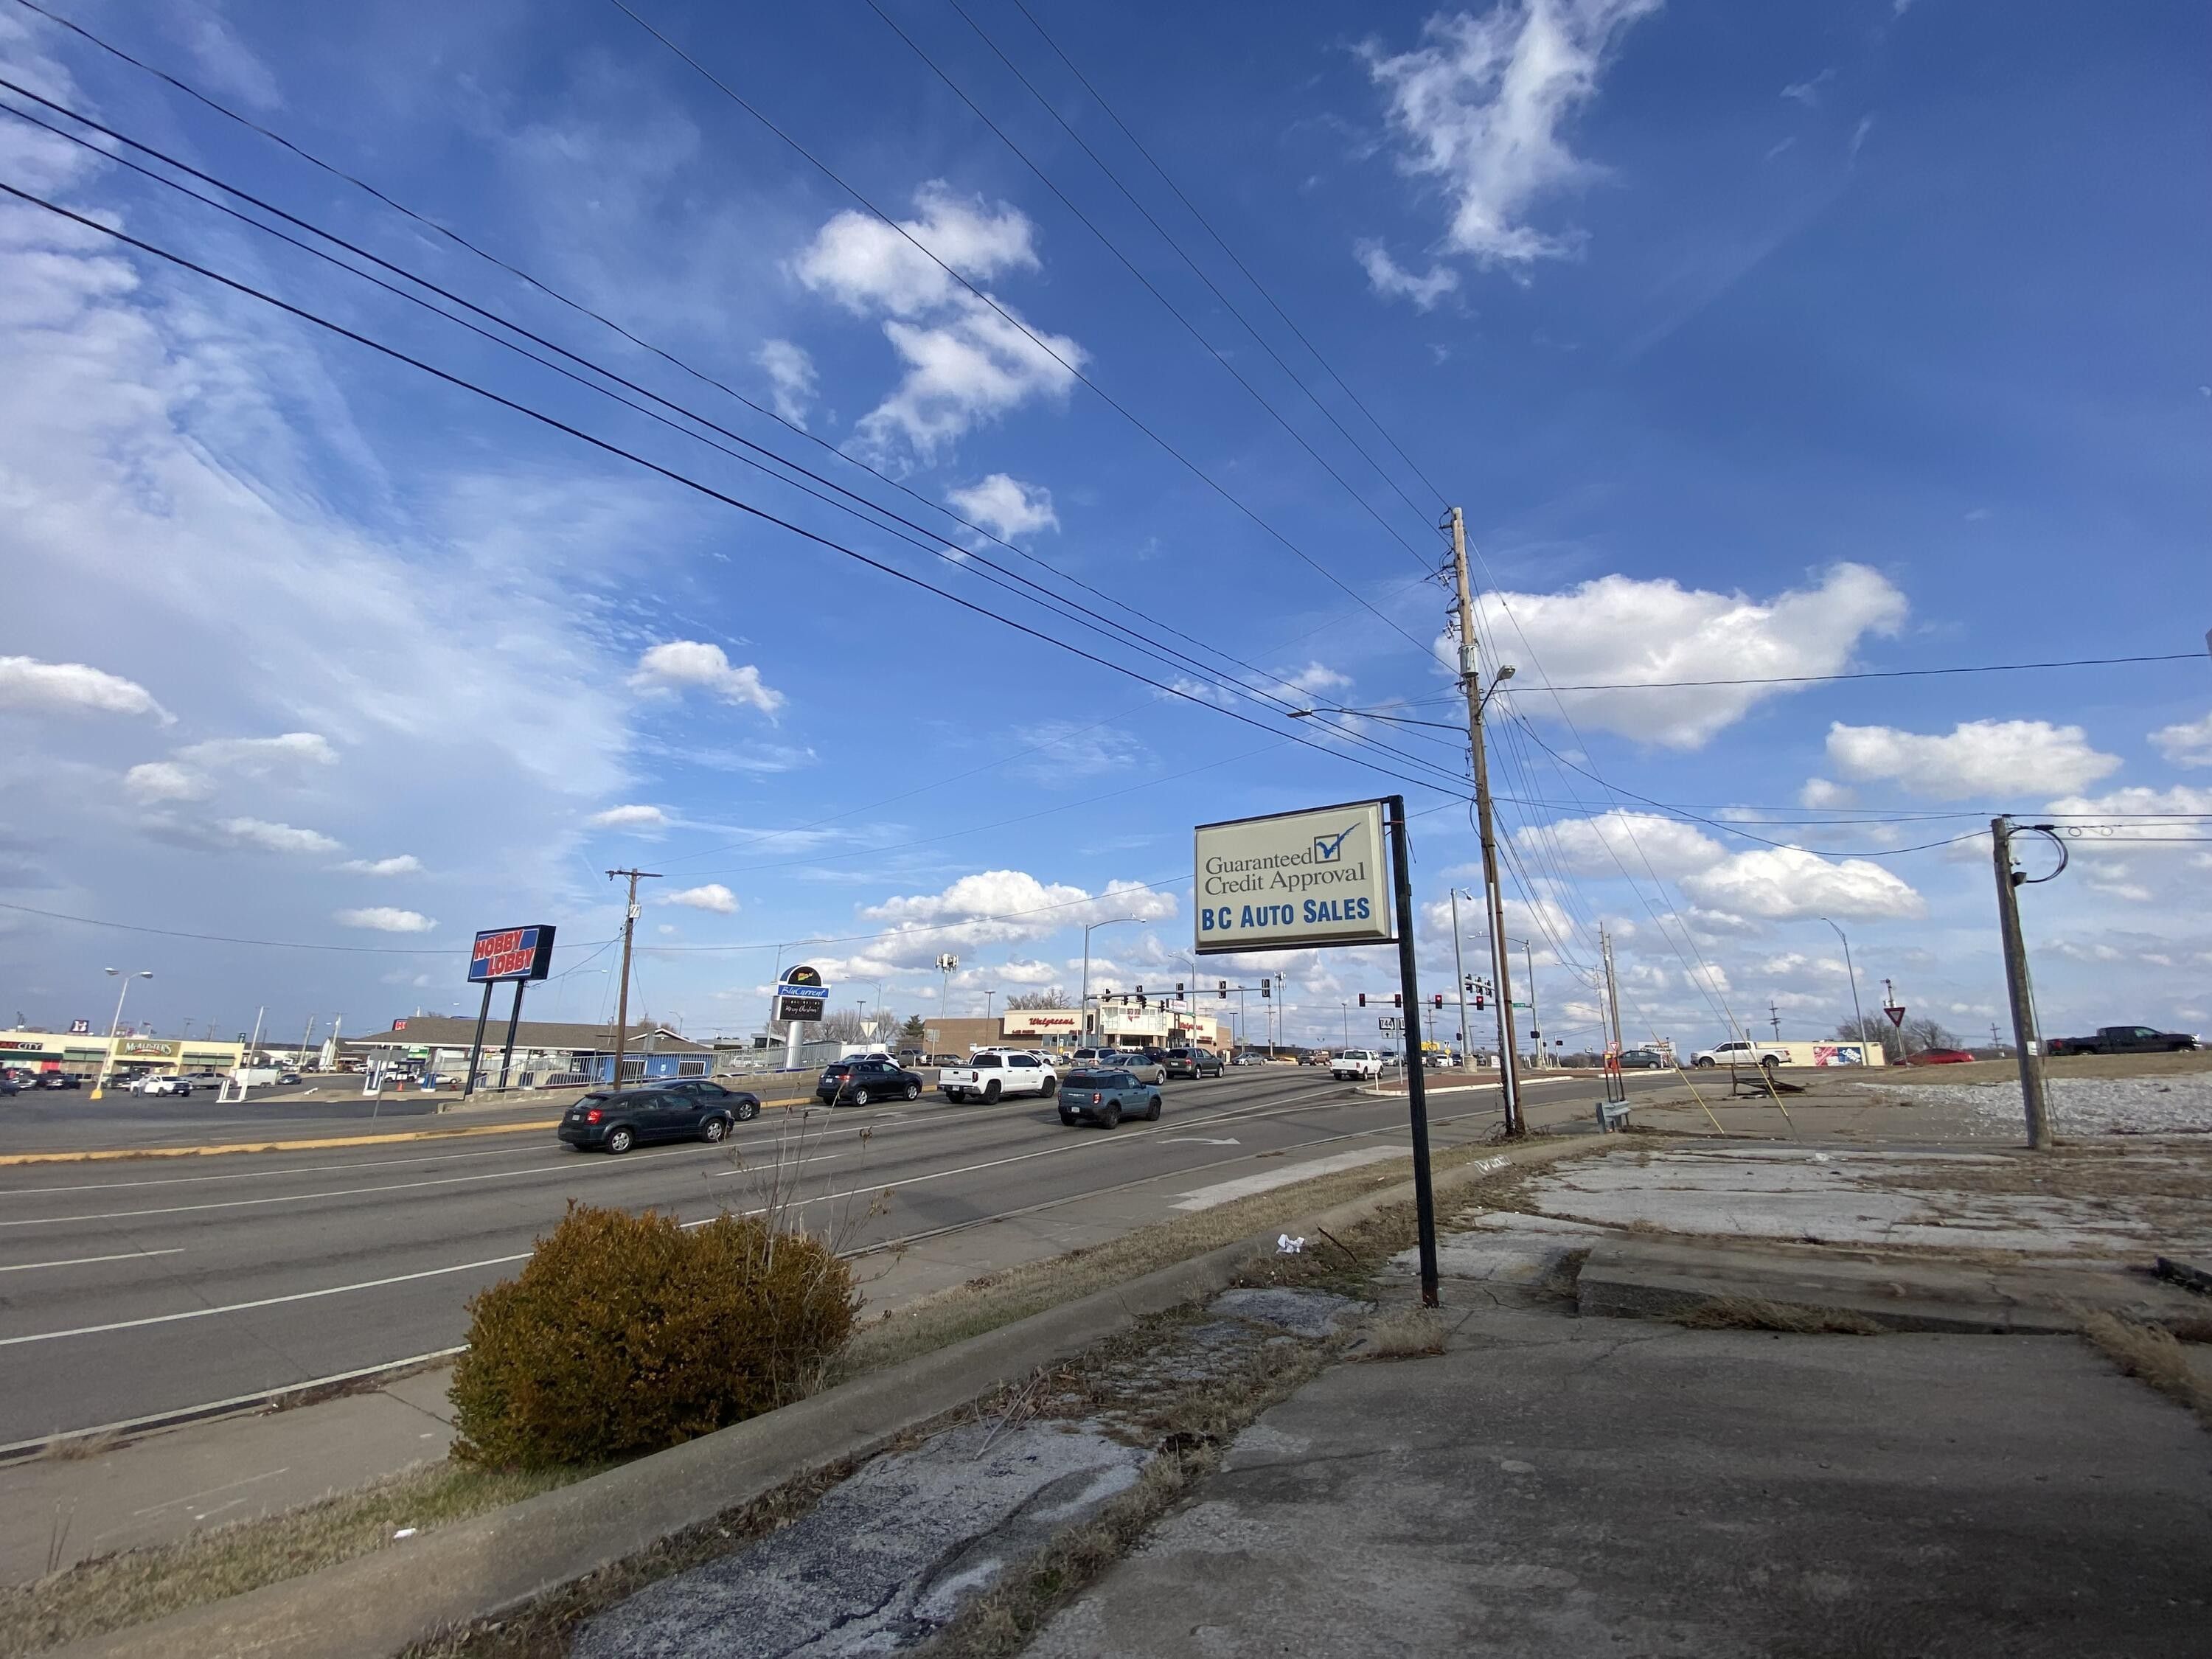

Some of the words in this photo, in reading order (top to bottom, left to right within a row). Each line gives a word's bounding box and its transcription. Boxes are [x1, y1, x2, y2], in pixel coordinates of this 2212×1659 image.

[1206, 847, 1313, 874] Guaranteed
[1205, 874, 1264, 895] Credit
[1269, 862, 1366, 894] Approval
[1202, 906, 1231, 931] BC
[474, 929, 524, 960] HOBBY
[487, 948, 535, 977] LOBBY
[1029, 1018, 1075, 1027] Walgreens
[17, 1042, 41, 1050] CITY
